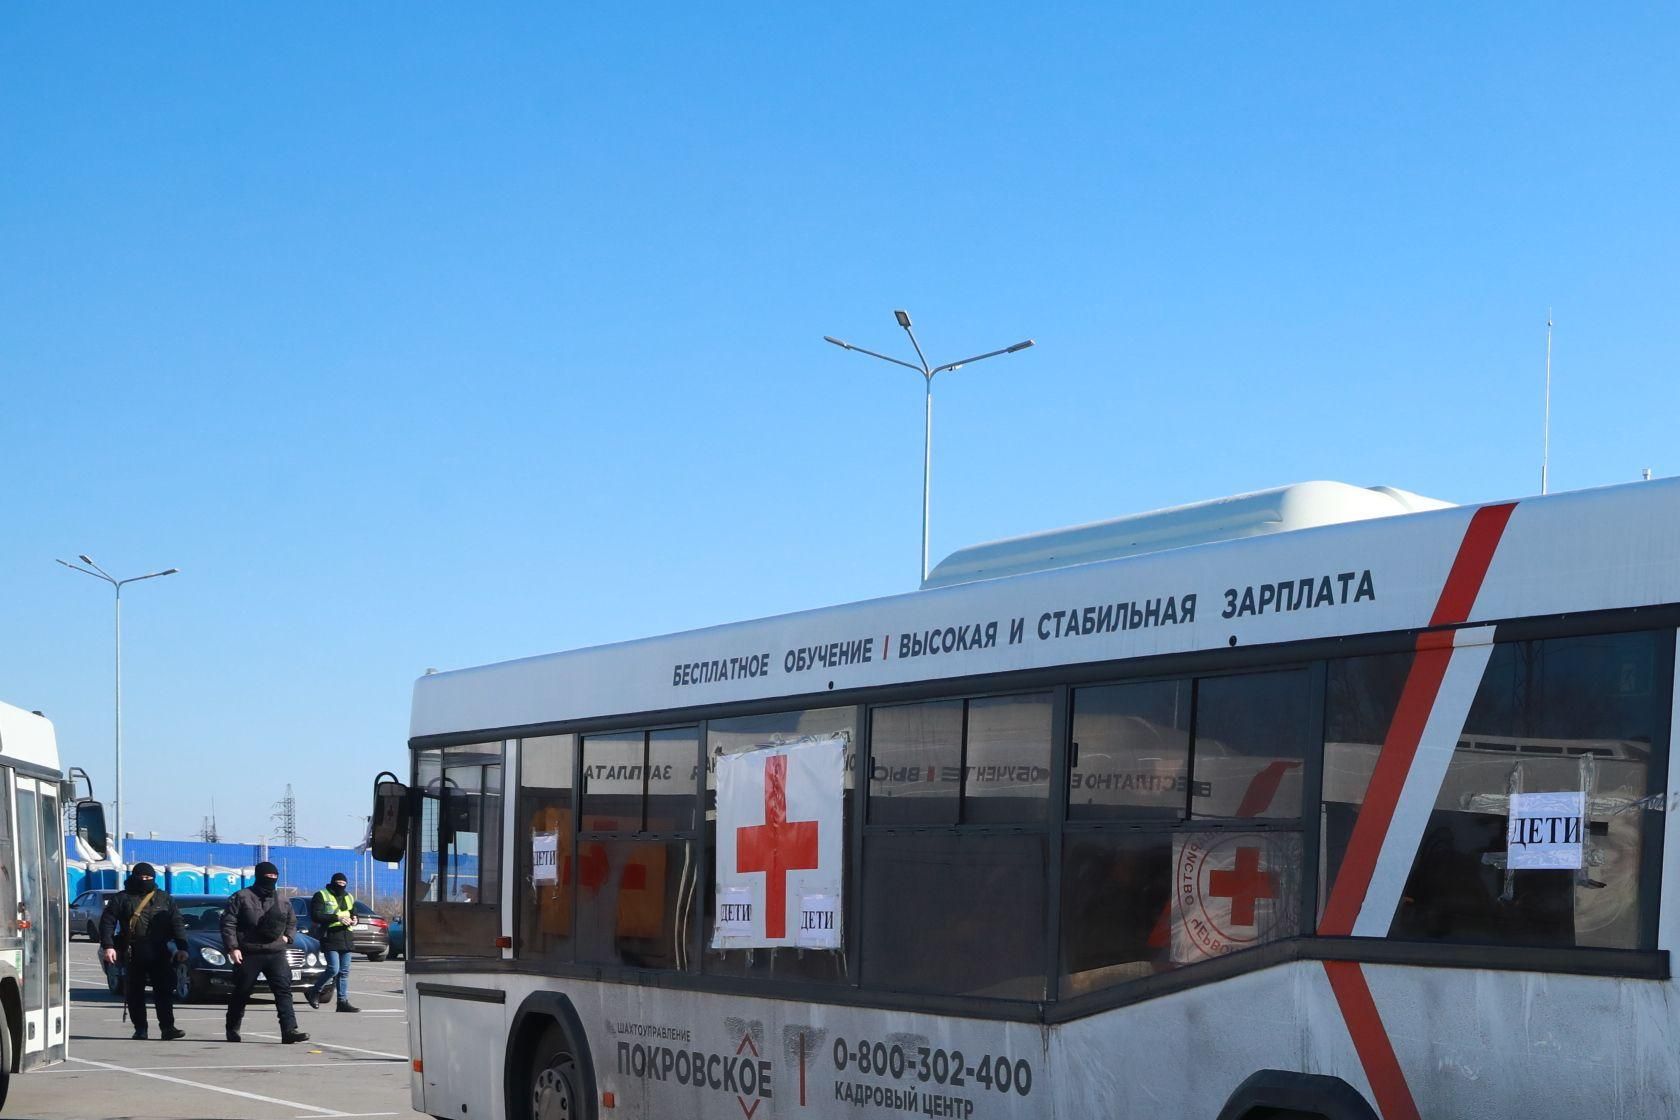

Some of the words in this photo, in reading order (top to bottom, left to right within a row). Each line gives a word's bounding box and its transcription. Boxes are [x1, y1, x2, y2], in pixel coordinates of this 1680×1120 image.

[672, 652, 770, 687] БЕСПЛАТНОЕ
[784, 636, 873, 673] ОБУЧЕНИЕ
[899, 621, 998, 659] ВЫСОКАЯ
[1009, 617, 1025, 645] И
[1037, 593, 1197, 641] СТАБИЛЬНАЯ
[1221, 569, 1376, 619] ЗАРПЛАТА
[1510, 817, 1582, 850] ДЕТИ
[720, 902, 752, 923] ДЕТИ
[801, 910, 834, 930] ДЕТИ
[617, 1022, 691, 1042] ШАХТОУПРАВЛЕНИЕ
[617, 1041, 773, 1099] ПОКРОВСКОЕ
[833, 1036, 1033, 1097] 0-800-302-400
[834, 1080, 919, 1114] КАДРОВЫЙ
[922, 1093, 975, 1120] ЦЕНТР
